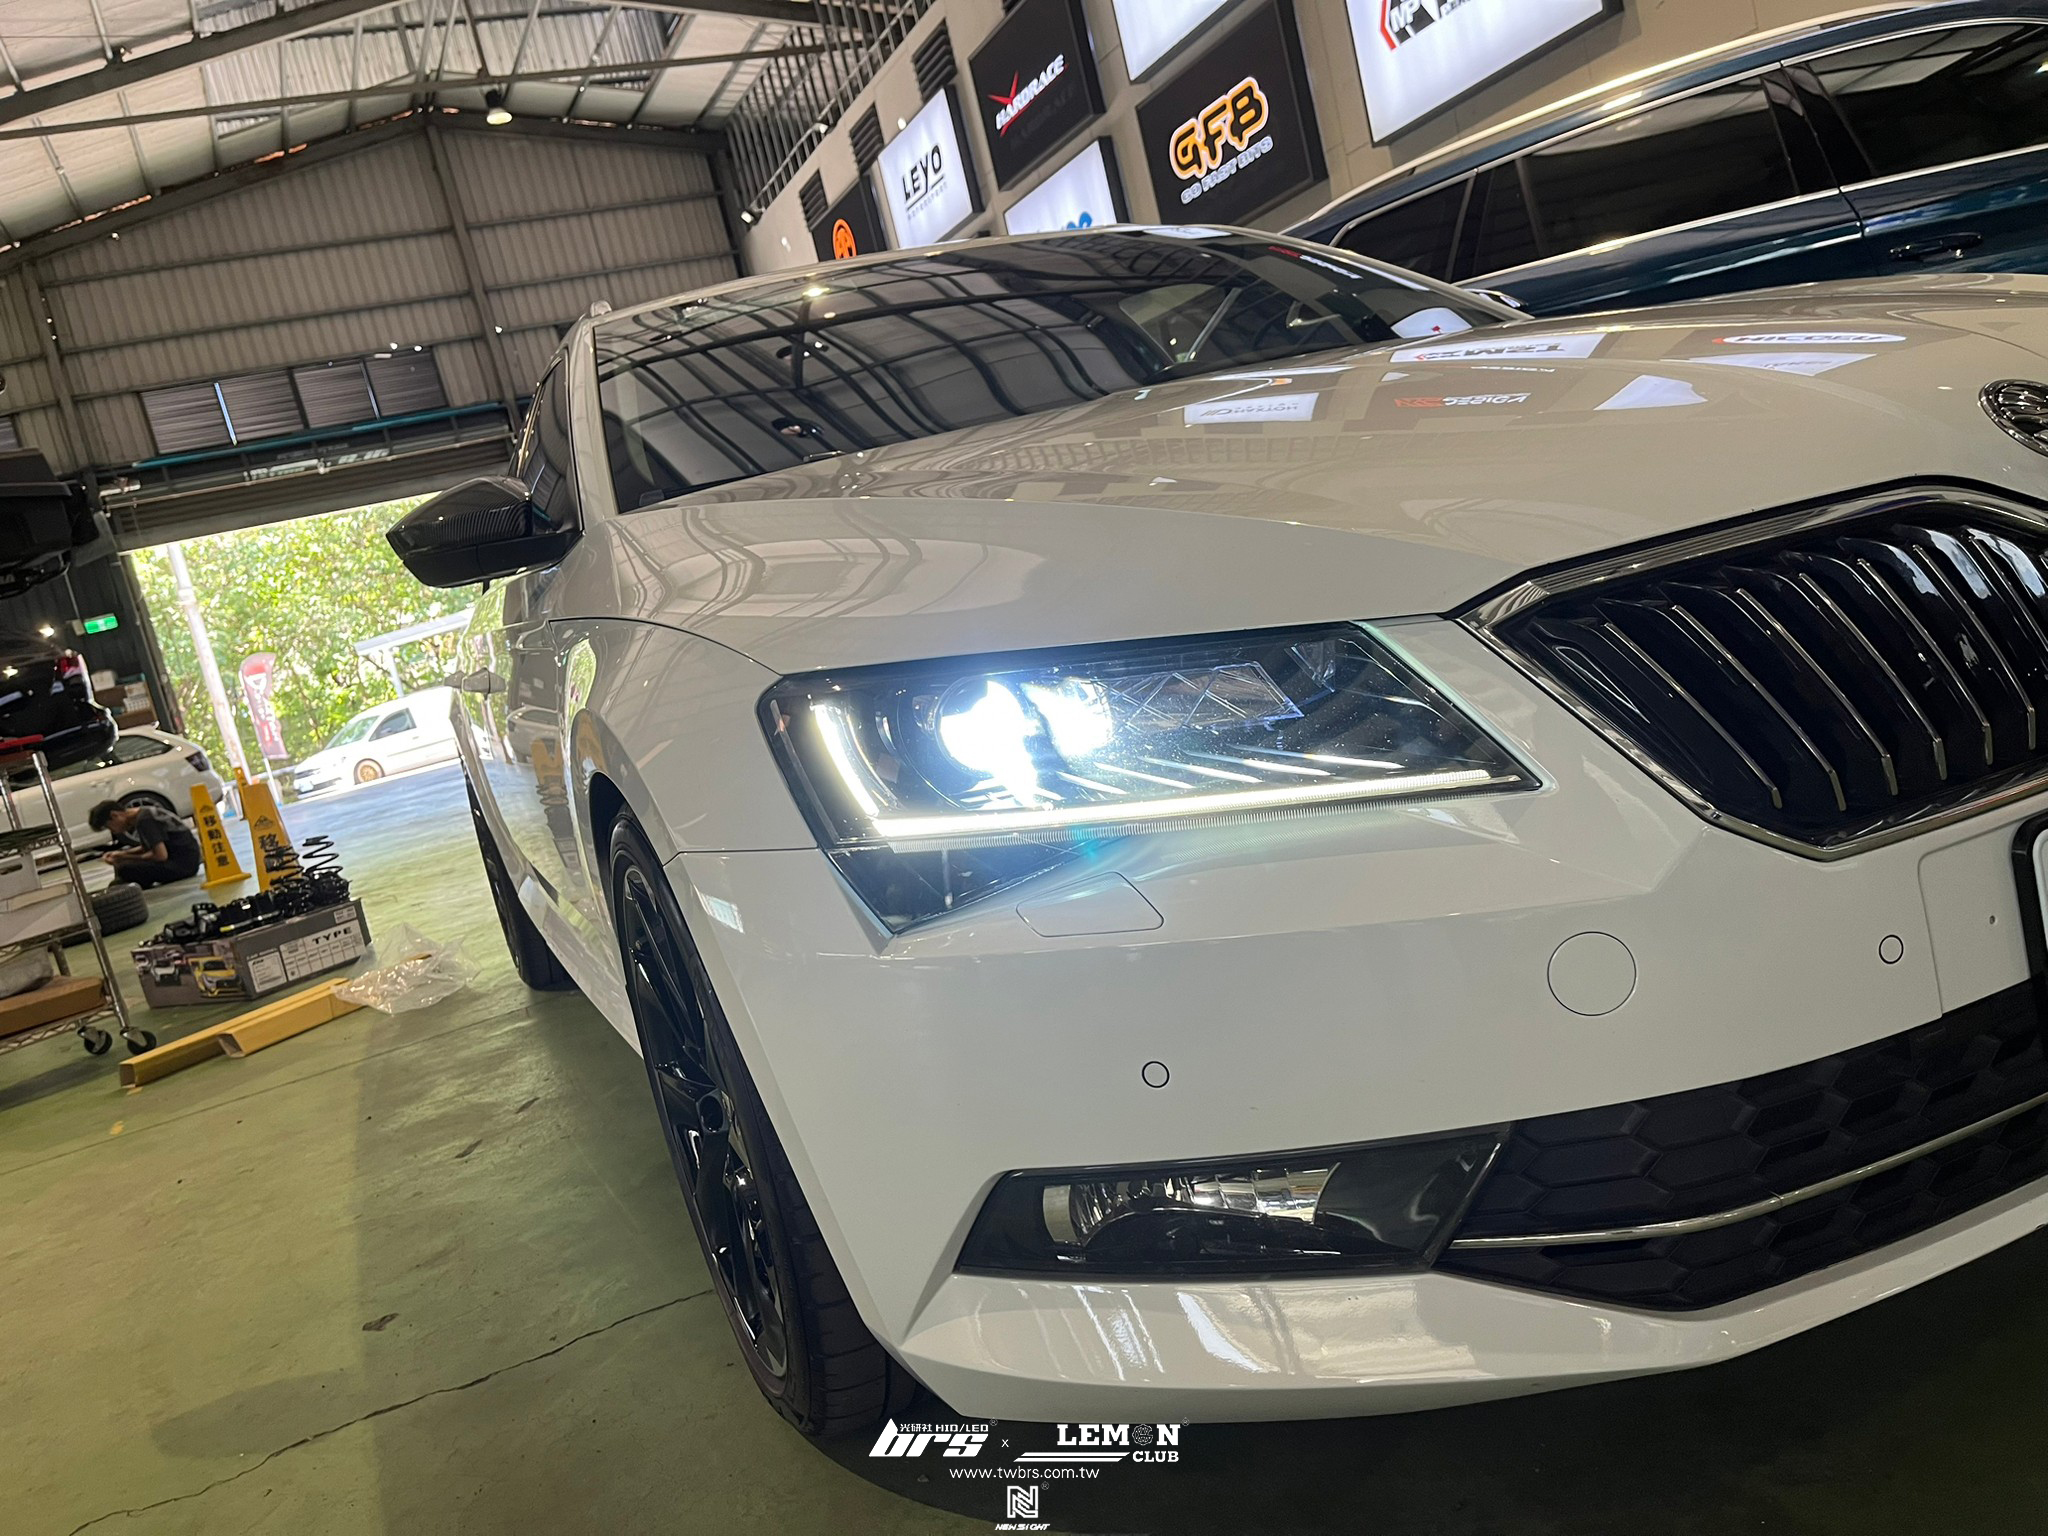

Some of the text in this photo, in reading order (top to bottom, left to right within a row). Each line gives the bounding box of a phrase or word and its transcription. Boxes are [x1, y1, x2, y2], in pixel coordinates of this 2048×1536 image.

[1169, 76, 1269, 180] GFB
[902, 144, 942, 202] LEYO
[1180, 181, 1203, 205] GO
[1201, 156, 1238, 193] FAST
[312, 926, 353, 945] TYPE
